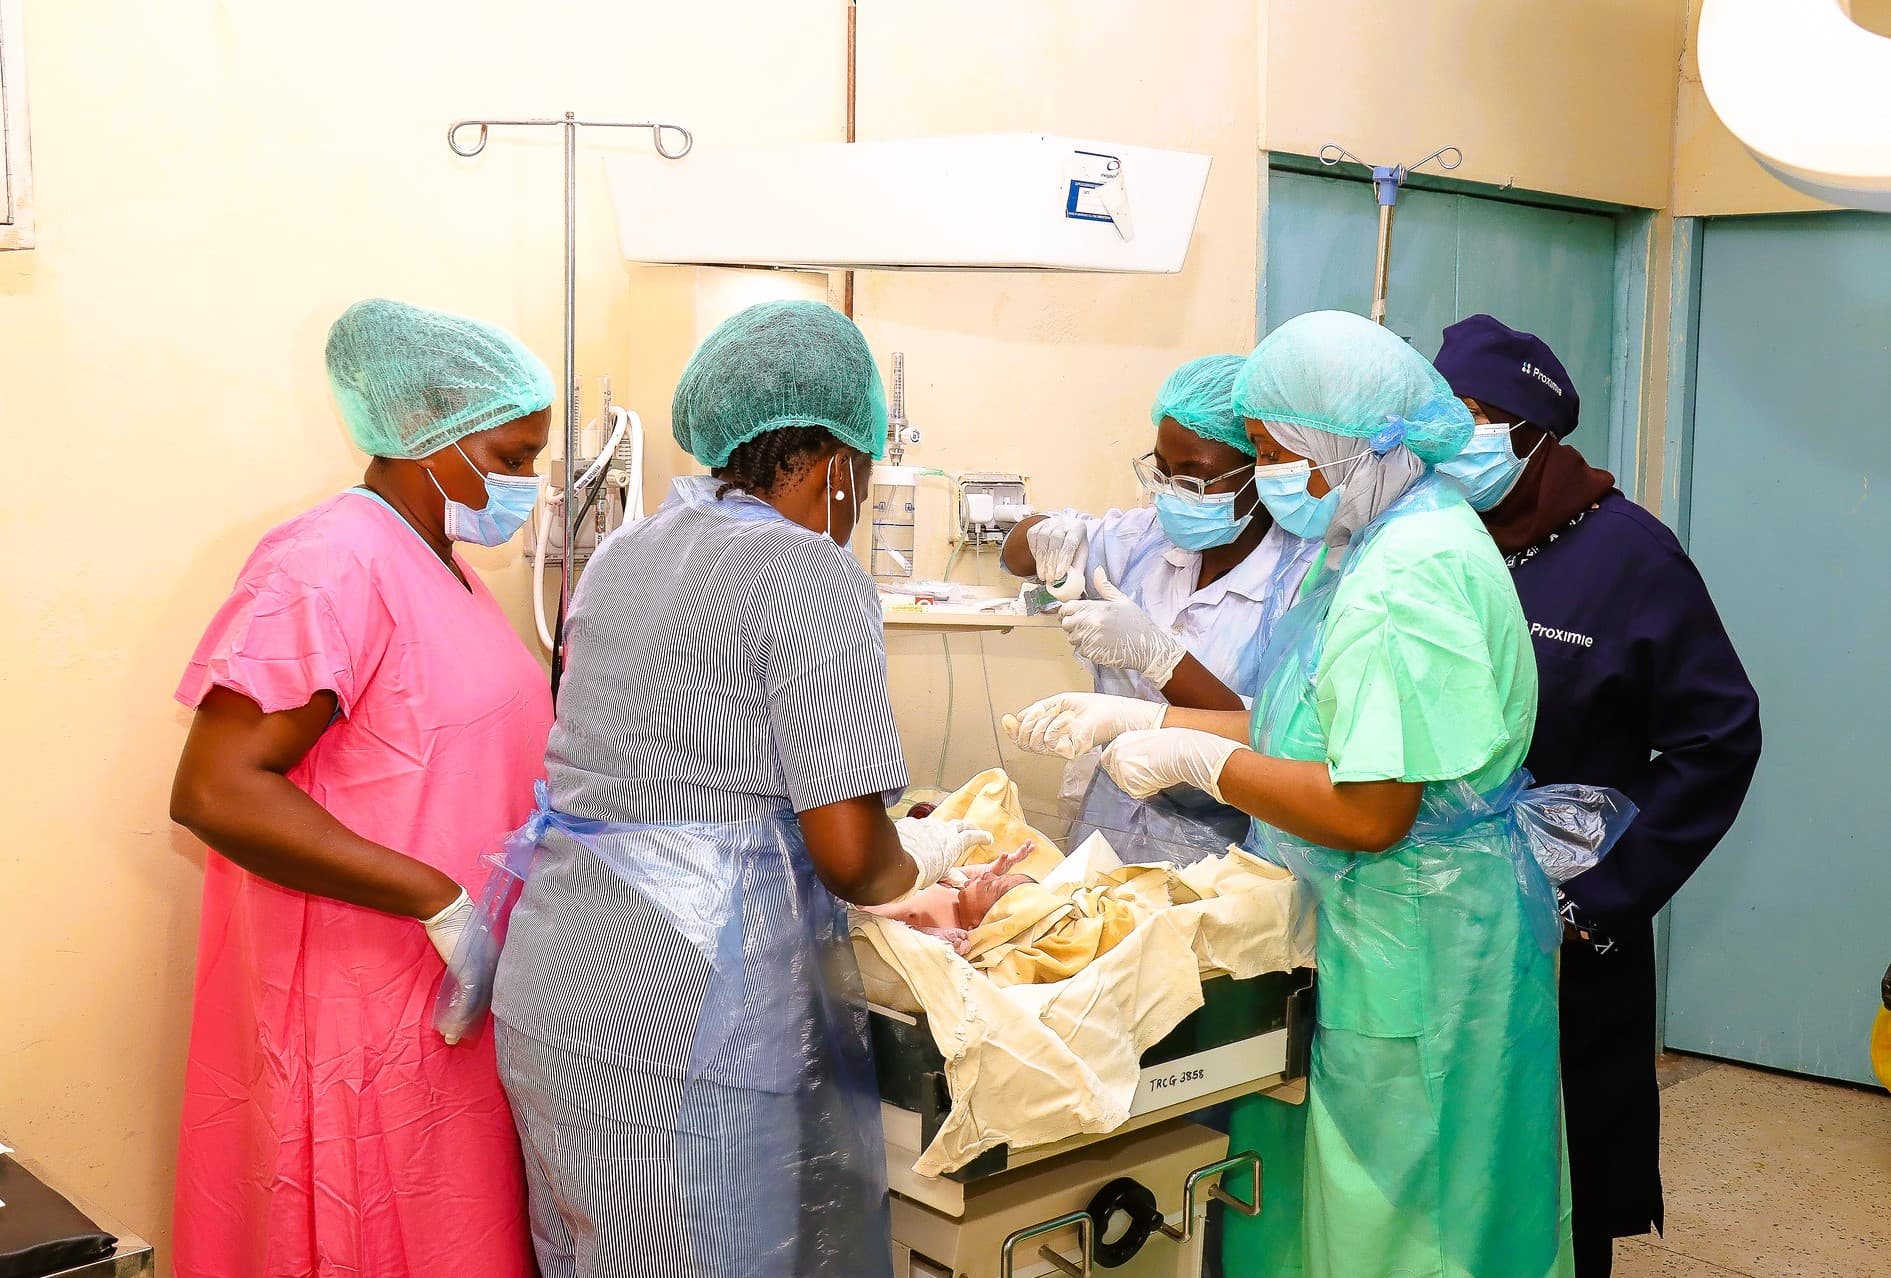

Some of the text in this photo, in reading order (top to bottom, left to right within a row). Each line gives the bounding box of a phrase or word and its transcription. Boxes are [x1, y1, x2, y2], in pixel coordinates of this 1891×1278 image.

[1530, 622, 1593, 648] Proximie
[1149, 1069, 1204, 1092] TRCG 3858
